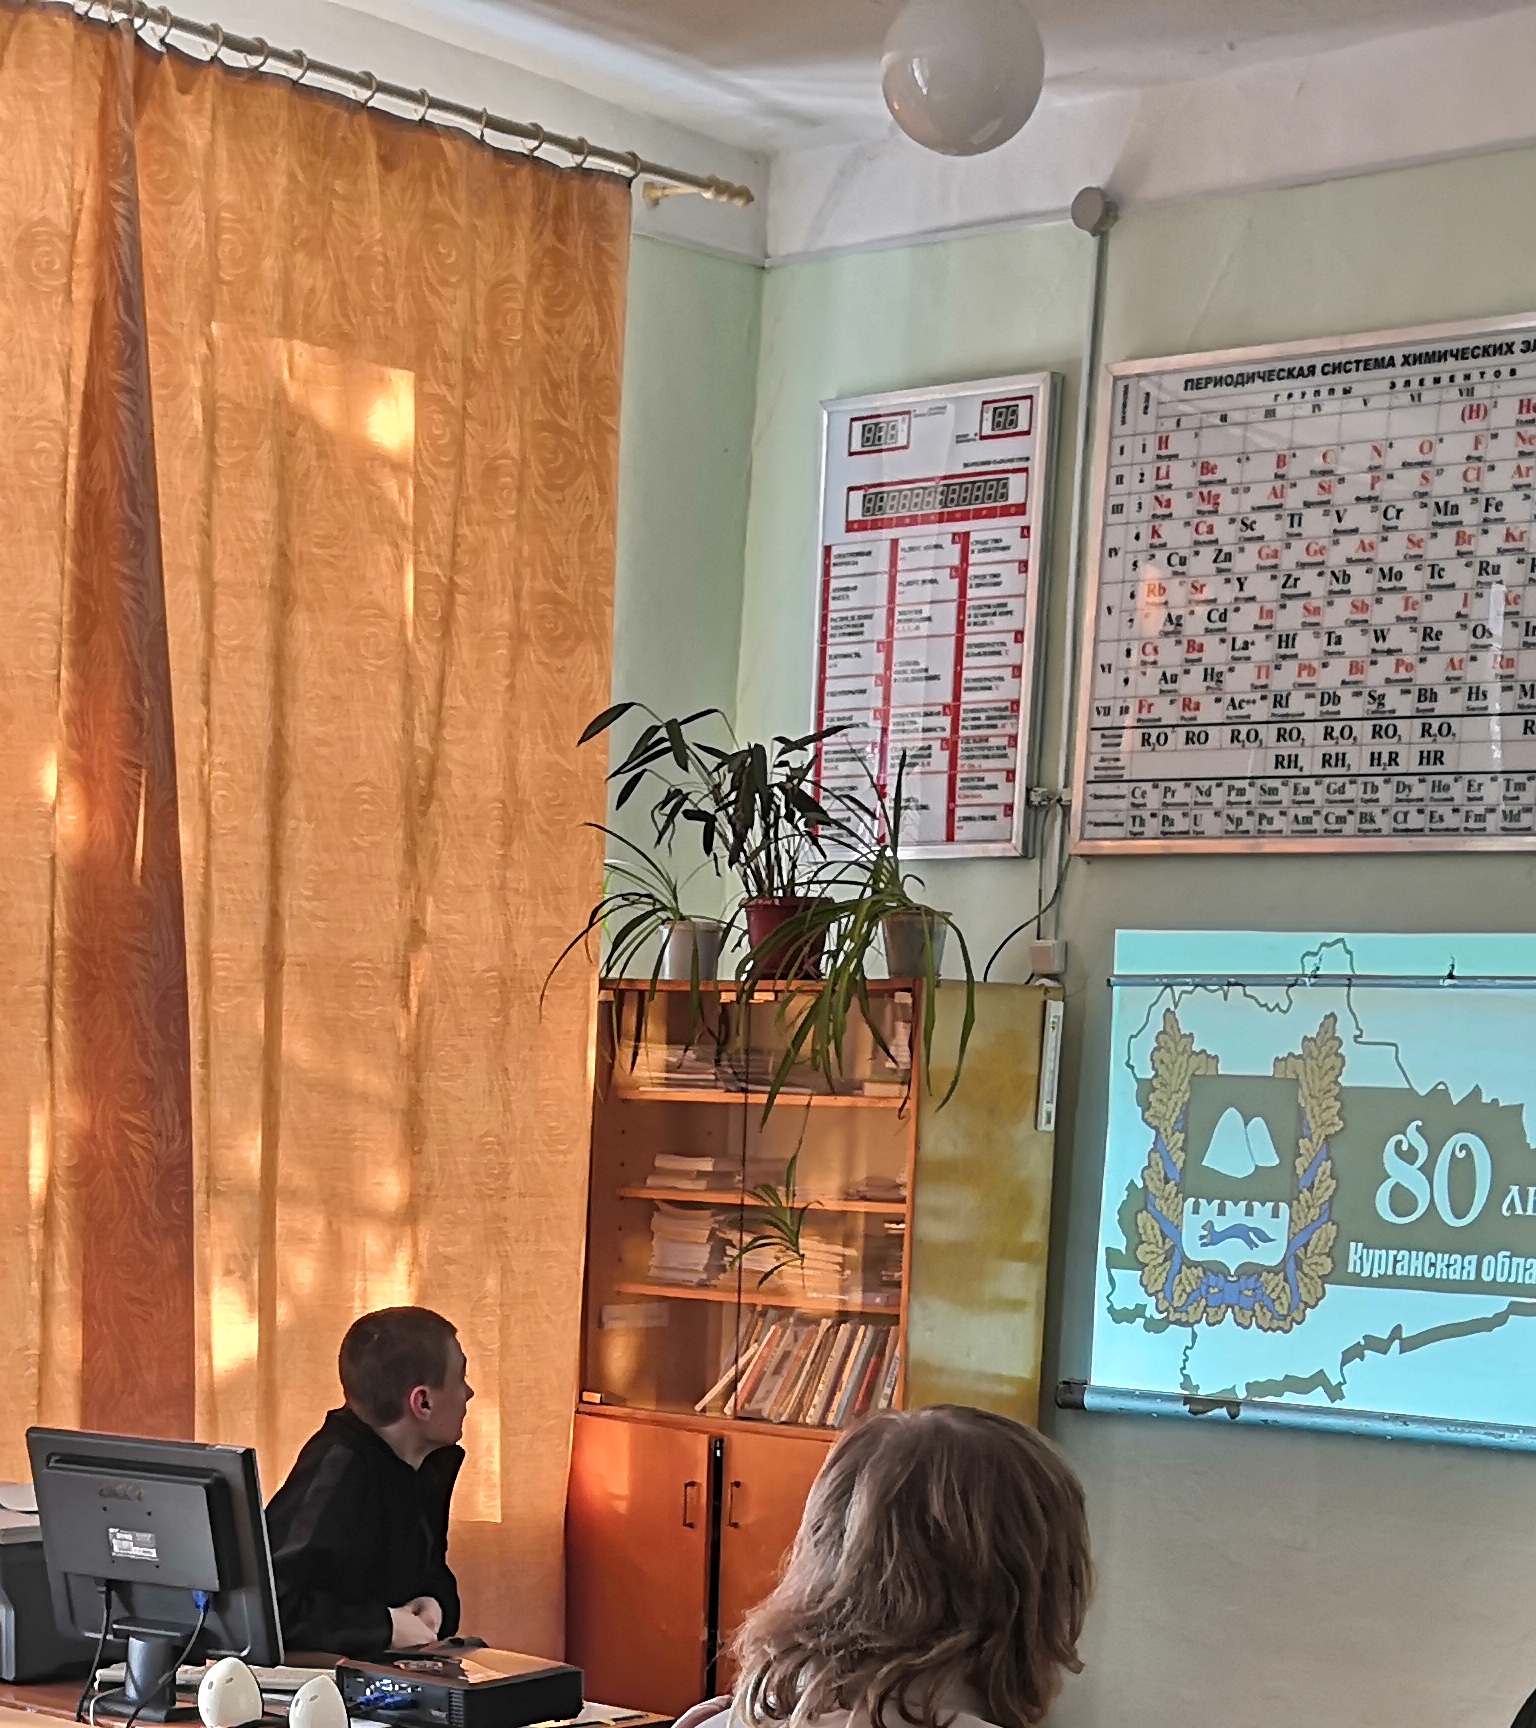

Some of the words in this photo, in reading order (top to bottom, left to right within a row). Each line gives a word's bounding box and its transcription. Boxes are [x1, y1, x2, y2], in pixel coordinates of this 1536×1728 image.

[1183, 364, 1316, 391] ПЕРИОДИЧЕСКАЯ
[1321, 354, 1396, 376] СИСТЕМА
[1400, 342, 1515, 367] ХИМИЧЕСКИХ
[1158, 434, 1170, 450] H
[1461, 403, 1489, 423] (H)
[1200, 460, 1218, 476] Be
[1419, 440, 1434, 456] O
[1153, 494, 1172, 509] Na
[1198, 490, 1221, 508] Mg
[1267, 484, 1286, 499] Al
[1420, 470, 1430, 486] S
[1462, 466, 1482, 484] Cl
[1514, 463, 1534, 479] Ar
[1151, 524, 1162, 539] K
[1194, 520, 1214, 536] Ca
[1240, 517, 1257, 532] Sc
[1287, 513, 1304, 528] Ti
[1335, 508, 1348, 524] V
[1383, 504, 1404, 521] Cr
[1434, 500, 1460, 517] Mn
[1484, 497, 1504, 513] Fe
[1167, 551, 1187, 568] Cu
[1213, 549, 1232, 563] Zn
[1257, 545, 1280, 560] Ga
[1305, 542, 1326, 557] Ge
[1356, 539, 1375, 554] As
[1455, 531, 1475, 547] Br
[1505, 527, 1528, 543] Kr
[1147, 582, 1166, 598] Rb
[1190, 580, 1207, 595] Sr
[1236, 576, 1248, 592] Y
[1282, 574, 1300, 589] Zr
[1329, 570, 1351, 585] Nb
[1377, 566, 1403, 584] Mo
[1429, 563, 1446, 580] Tc
[1477, 560, 1501, 577] Ru
[1164, 612, 1183, 628] Ag
[1207, 608, 1228, 623] Cd
[1258, 606, 1273, 621] In
[1302, 602, 1322, 617] Sn
[1350, 599, 1370, 614] Sb
[1402, 595, 1420, 613] Te
[1462, 592, 1469, 609] I
[1141, 641, 1160, 657] Cs
[1186, 639, 1204, 654] Ba
[1278, 633, 1298, 649] Hf
[1325, 632, 1343, 647] Ta
[1373, 628, 1391, 645] W
[1422, 626, 1443, 642] Re
[1159, 670, 1178, 685] Au
[1203, 667, 1224, 684] Hg
[1297, 662, 1317, 678] Pb
[1349, 659, 1364, 676] Bi
[1394, 657, 1414, 673] Po
[1138, 699, 1154, 714] Fr
[1182, 697, 1201, 712] Ra
[1272, 693, 1292, 709] Rf
[1320, 690, 1341, 707] Db
[1367, 690, 1386, 708] Sg
[1417, 687, 1438, 704] Bh
[1467, 685, 1488, 702] Hs
[1185, 730, 1209, 745] RO
[1419, 749, 1445, 766] HR
[1375, 1120, 1492, 1228] 80
[1348, 1241, 1477, 1281] Курганская
